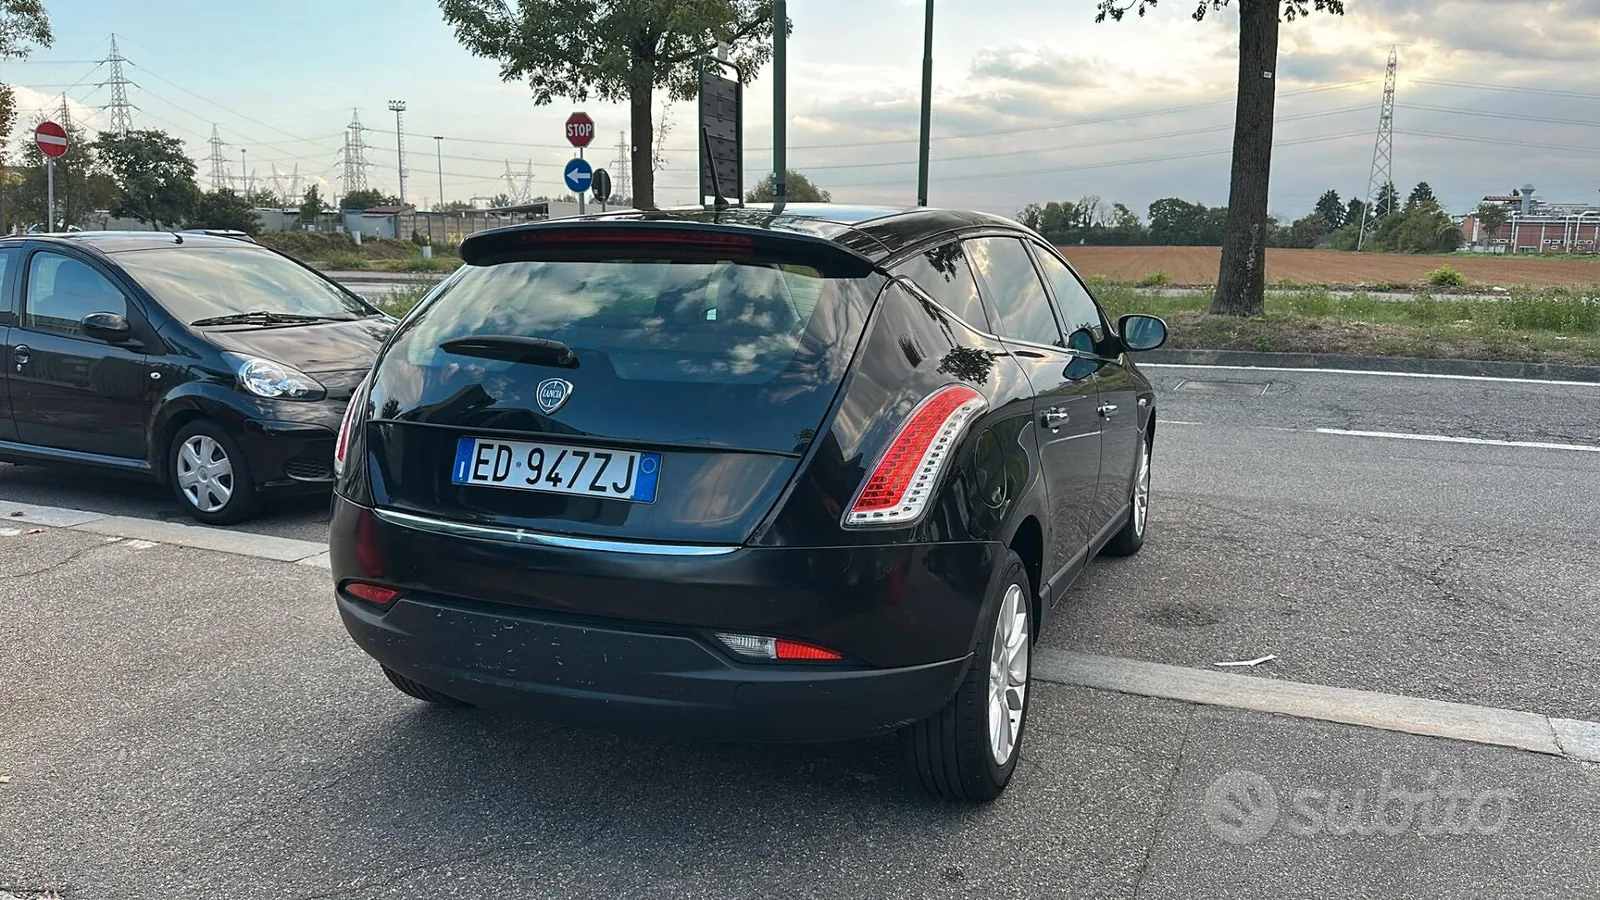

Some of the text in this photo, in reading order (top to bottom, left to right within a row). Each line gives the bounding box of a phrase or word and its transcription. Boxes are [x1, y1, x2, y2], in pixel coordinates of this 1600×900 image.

[567, 124, 592, 137] STOP
[542, 388, 562, 399] LANCIA
[472, 443, 635, 494] ED 947ZJ
